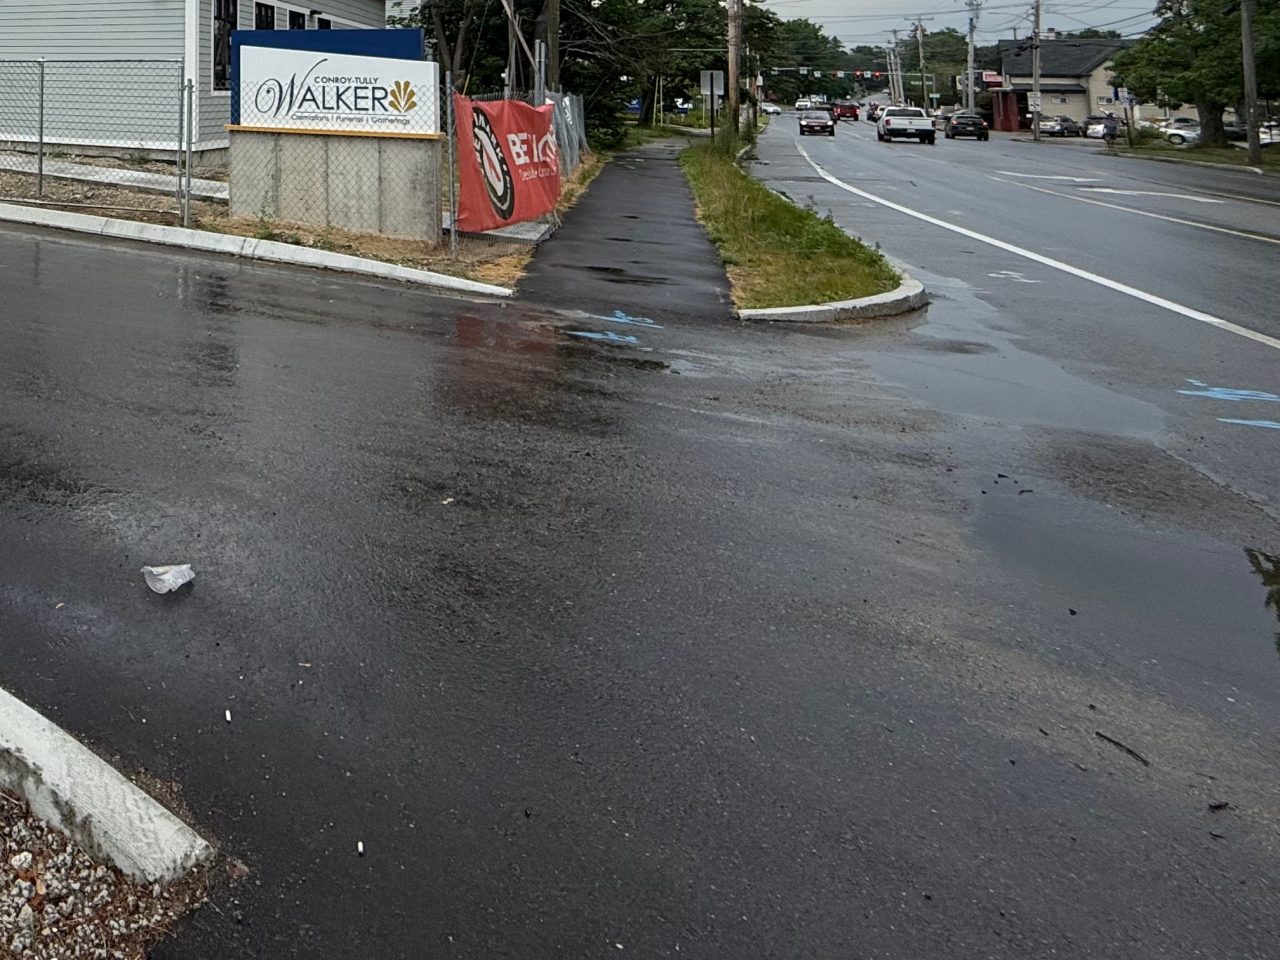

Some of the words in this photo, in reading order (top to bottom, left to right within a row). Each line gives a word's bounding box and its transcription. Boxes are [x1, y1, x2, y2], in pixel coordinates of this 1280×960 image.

[314, 76, 379, 85] CONROY-TULLY
[255, 58, 389, 118] WALKER
[291, 113, 329, 122] Cremations
[336, 115, 364, 123] Funerals
[371, 116, 410, 125] Gatherings
